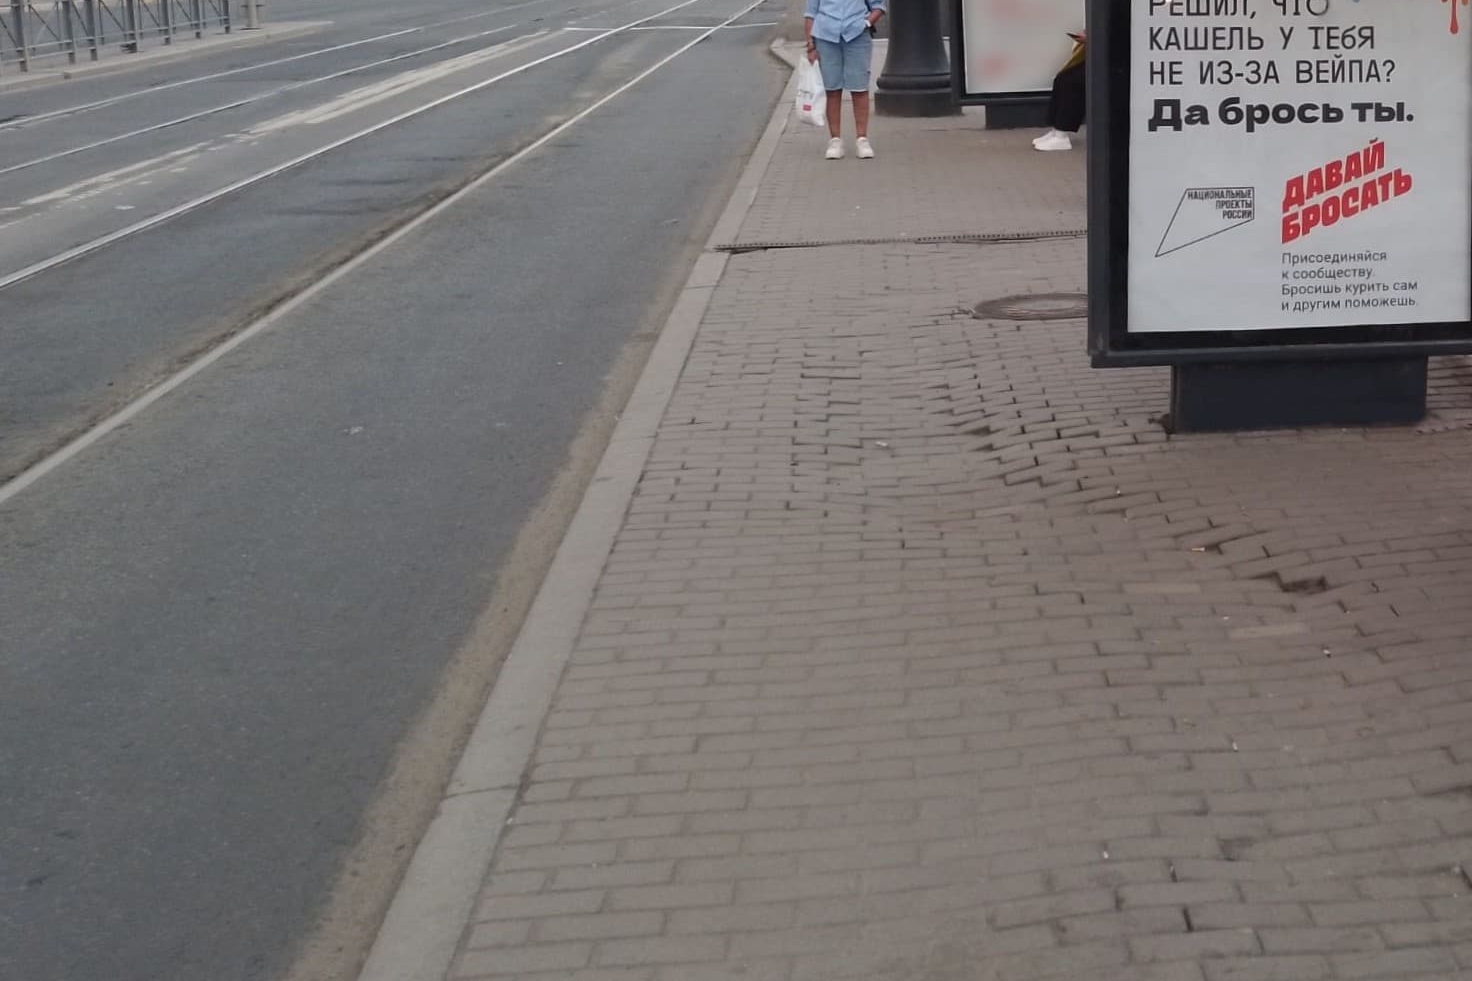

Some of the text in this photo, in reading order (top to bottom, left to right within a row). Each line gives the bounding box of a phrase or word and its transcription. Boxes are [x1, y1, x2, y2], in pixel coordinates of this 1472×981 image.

[1149, 26, 1264, 51] КАШЕЛЬ
[1280, 26, 1294, 50] У
[1149, 53, 1396, 85] НЕ ИЗ-ЗА ВЕЙПА?
[1148, 97, 1414, 133] Да брось ты.
[1283, 137, 1385, 214] ДАВАЙ
[1187, 189, 1252, 201] НАЦИОНАЛЬНЫЕ
[1215, 200, 1252, 209] ПРОЕКТЫ
[1281, 168, 1412, 244] БРОСАТЬ
[1222, 210, 1252, 219] РОССИИ
[1282, 250, 1387, 266] Присоединяйся
[1282, 271, 1289, 280] к
[1281, 281, 1418, 297] Бросишь курить сам
[1281, 302, 1289, 311] и
[1293, 299, 1341, 312] другим
